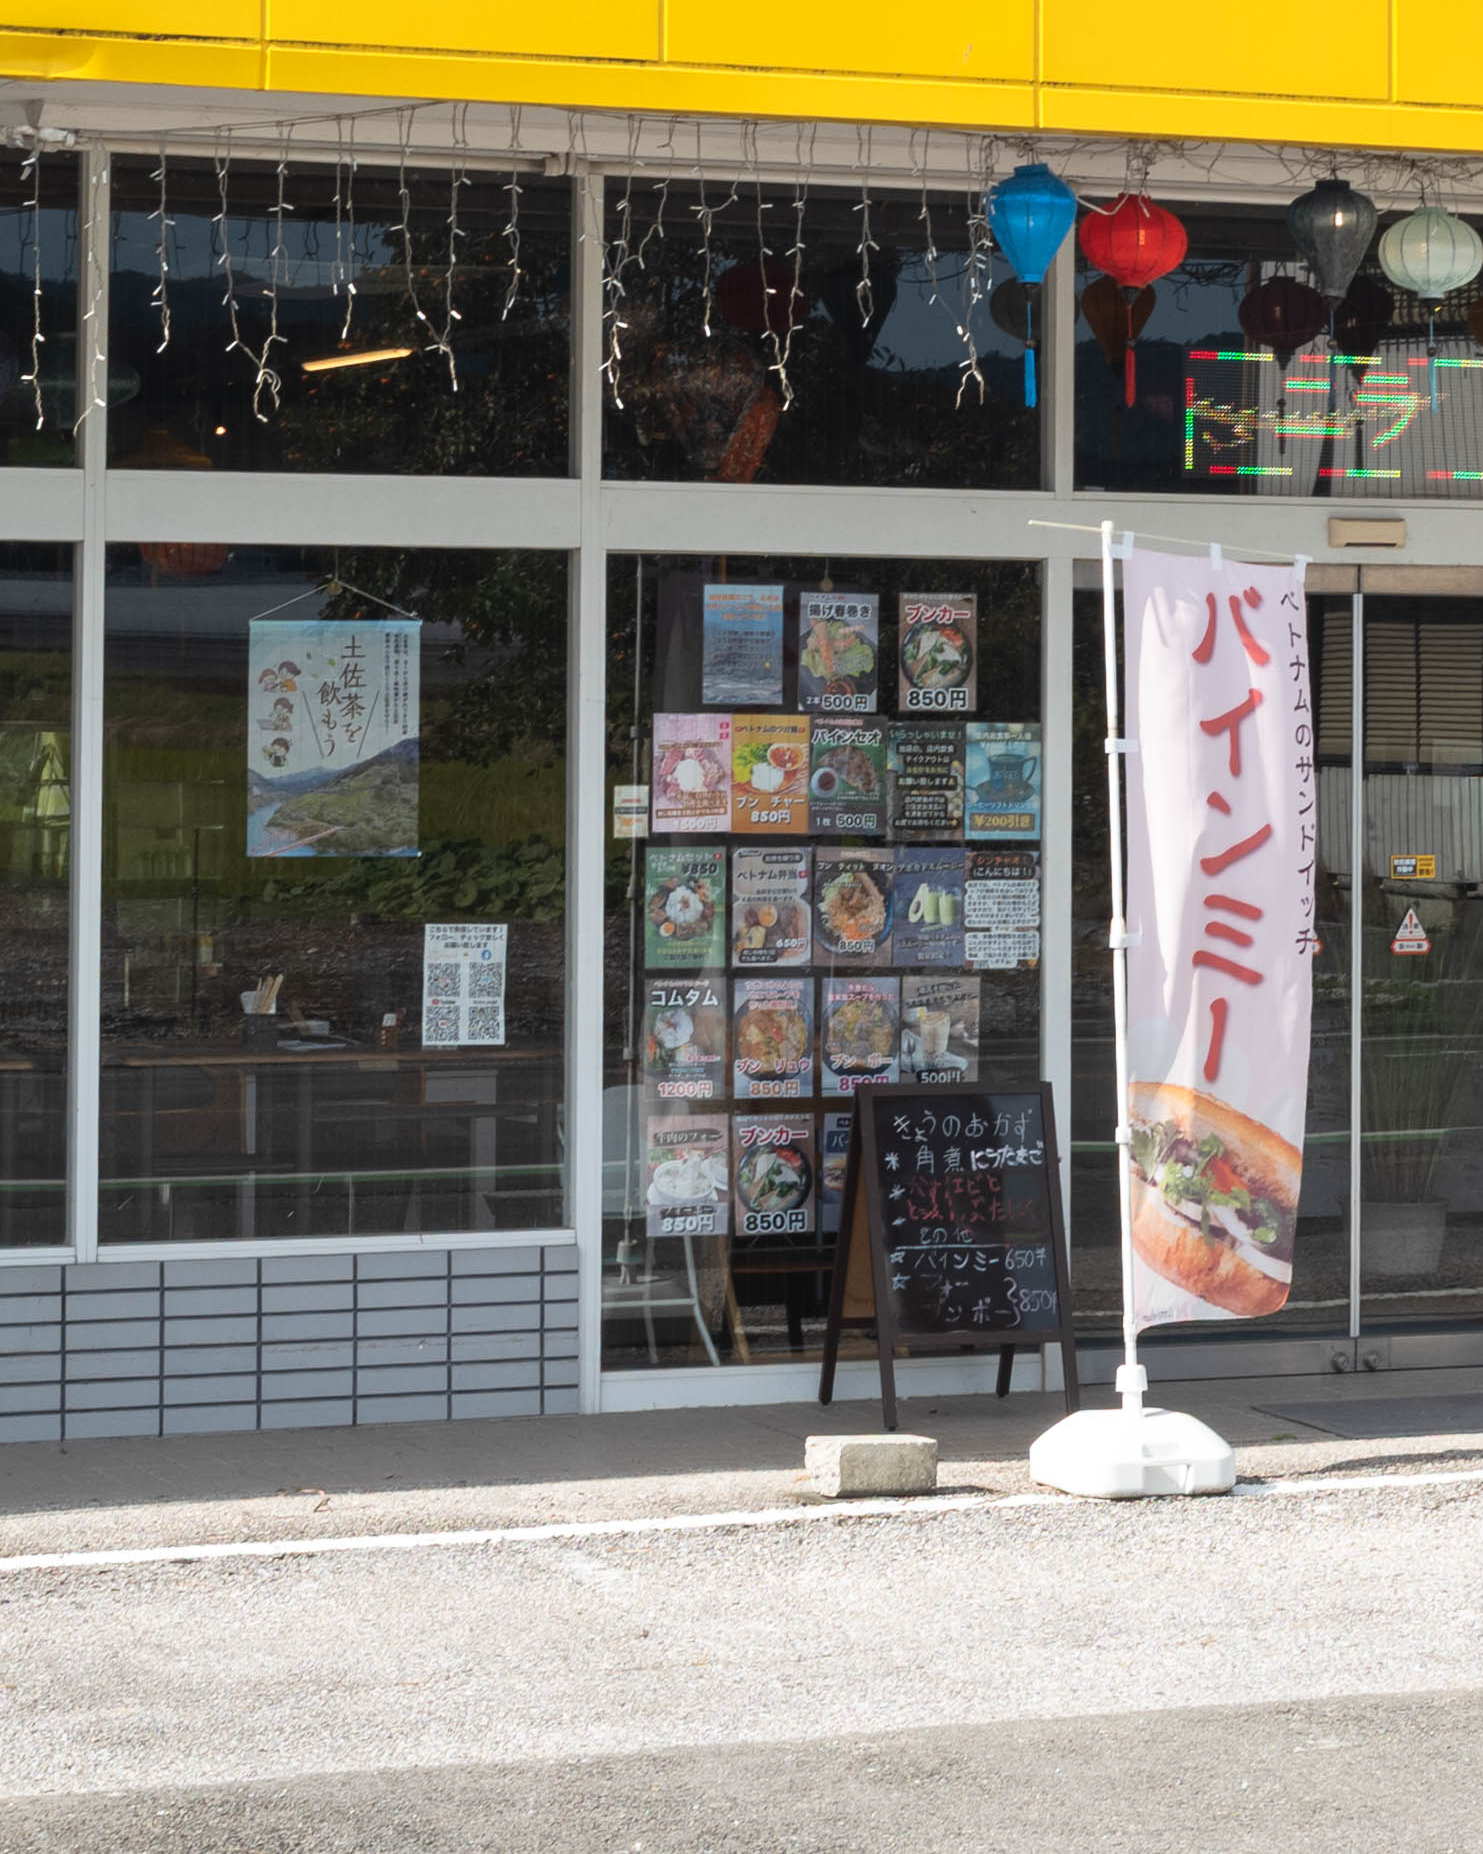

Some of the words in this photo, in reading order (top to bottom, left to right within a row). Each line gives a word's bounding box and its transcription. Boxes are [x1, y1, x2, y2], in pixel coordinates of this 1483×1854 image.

[808, 602, 871, 618] 揚げ春巻き
[907, 604, 970, 623] ブンカー
[339, 634, 367, 743] 土佐茶を
[822, 695, 868, 710] 500円
[908, 689, 968, 708] 850円
[317, 681, 343, 757] 飲もう
[811, 729, 881, 746] バインセオ
[1281, 591, 1315, 954] ベトナムのサンドイッチ
[751, 811, 791, 824] 850円
[836, 814, 876, 828] 500円
[1192, 586, 1271, 1084] バインミー
[737, 869, 798, 880] ベトナム弁当
[838, 939, 875, 953] 850円
[651, 988, 719, 1007] コムタム
[736, 1059, 761, 1074] ブン
[830, 1053, 857, 1069] ブン
[658, 1080, 713, 1098] 1200円
[751, 1080, 800, 1098] 850円
[739, 1125, 809, 1146] ブンカー
[662, 1215, 715, 1233] 850円
[744, 1209, 808, 1233] 850円
[914, 1251, 1000, 1272] バインミー
